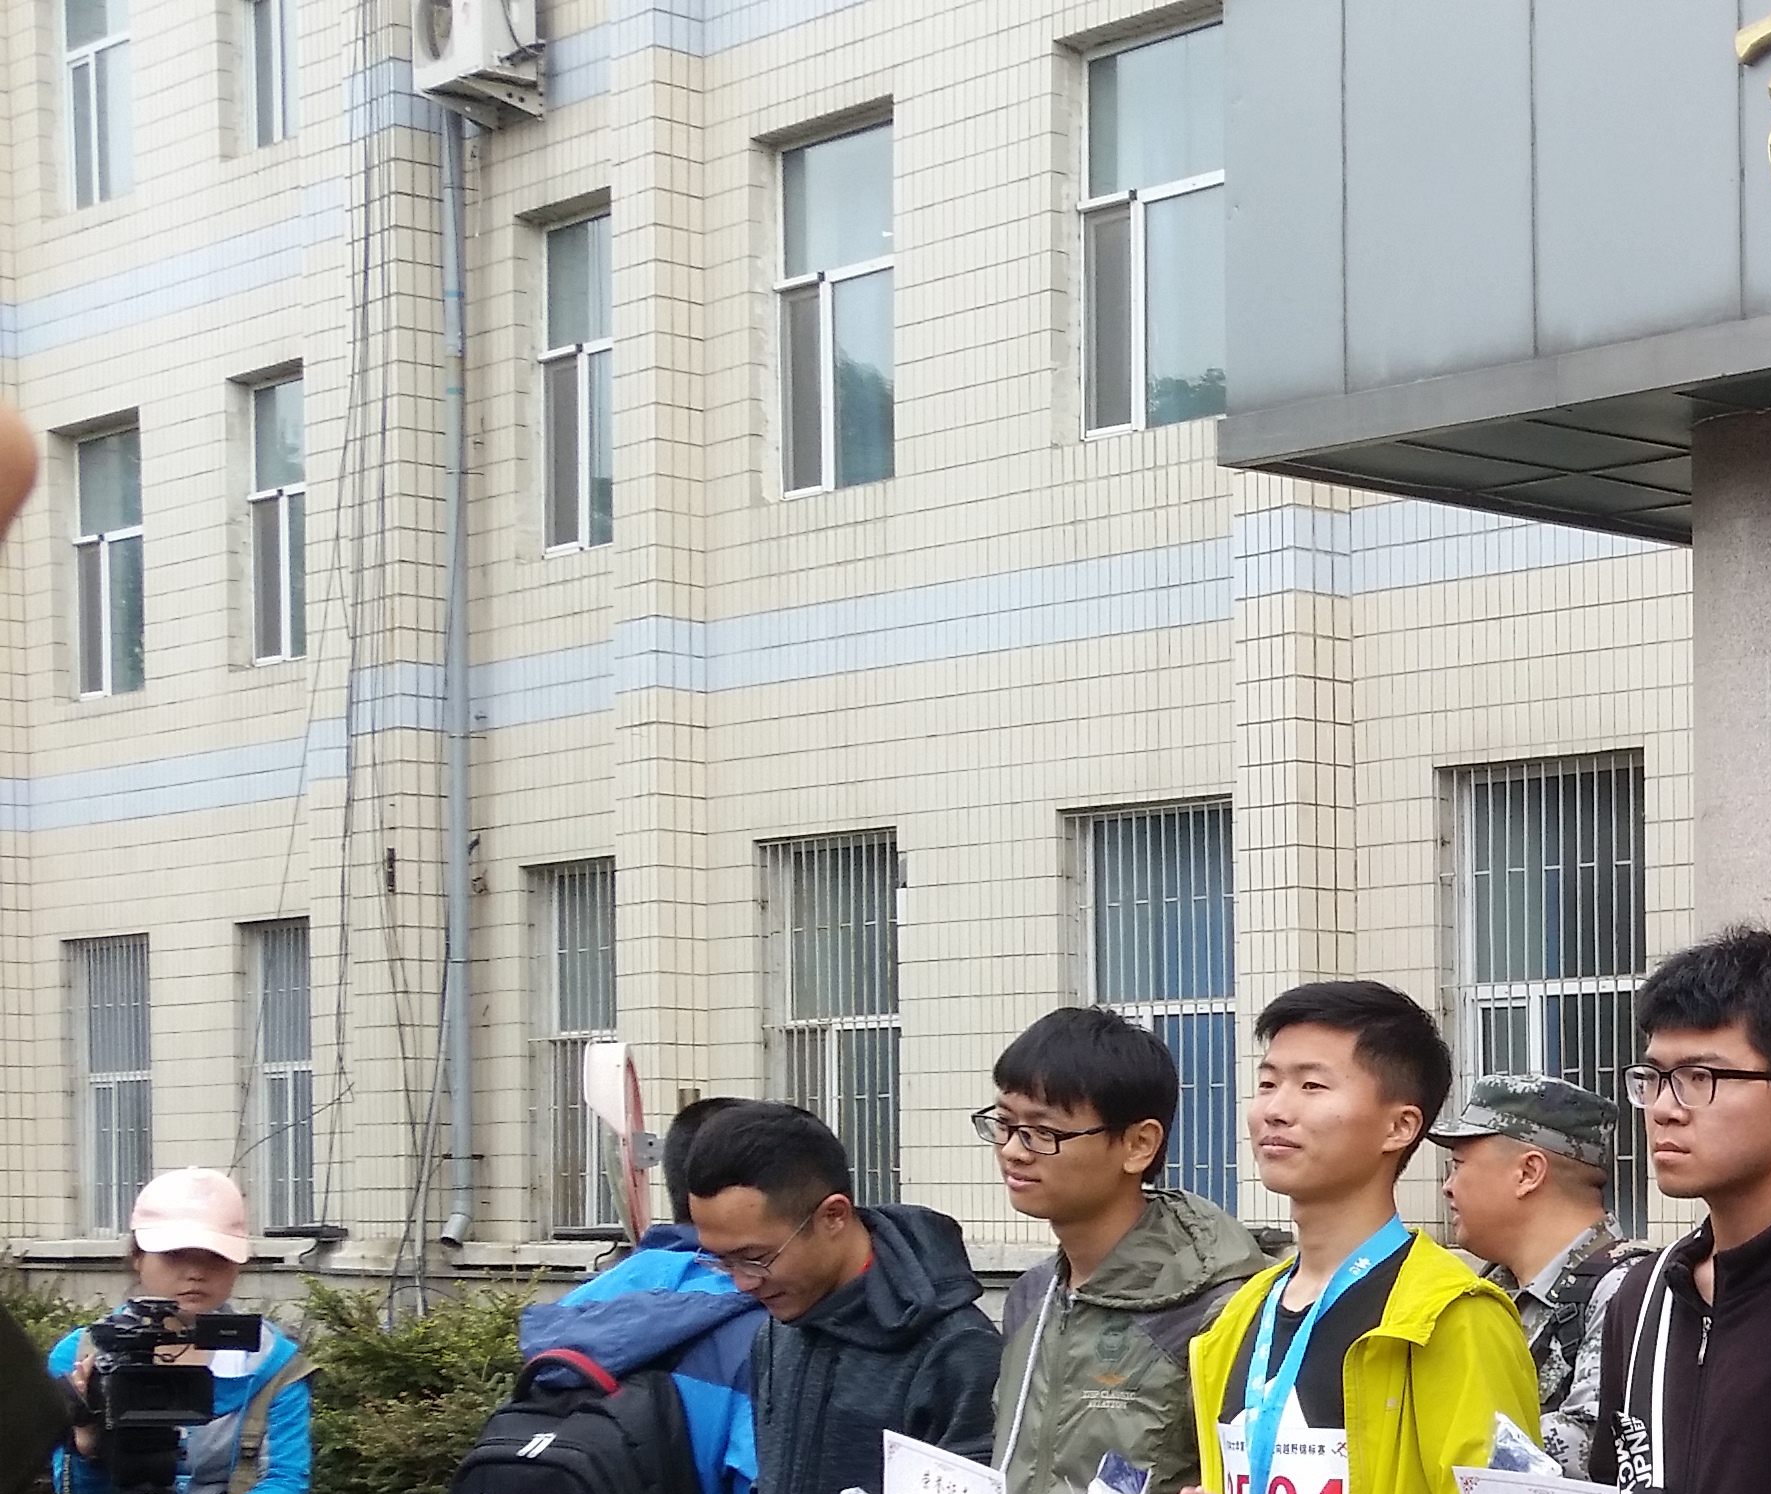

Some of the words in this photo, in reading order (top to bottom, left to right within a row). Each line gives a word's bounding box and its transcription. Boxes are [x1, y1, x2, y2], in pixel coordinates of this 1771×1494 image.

[1272, 1443, 1326, 1456] 向越野锦标赛
